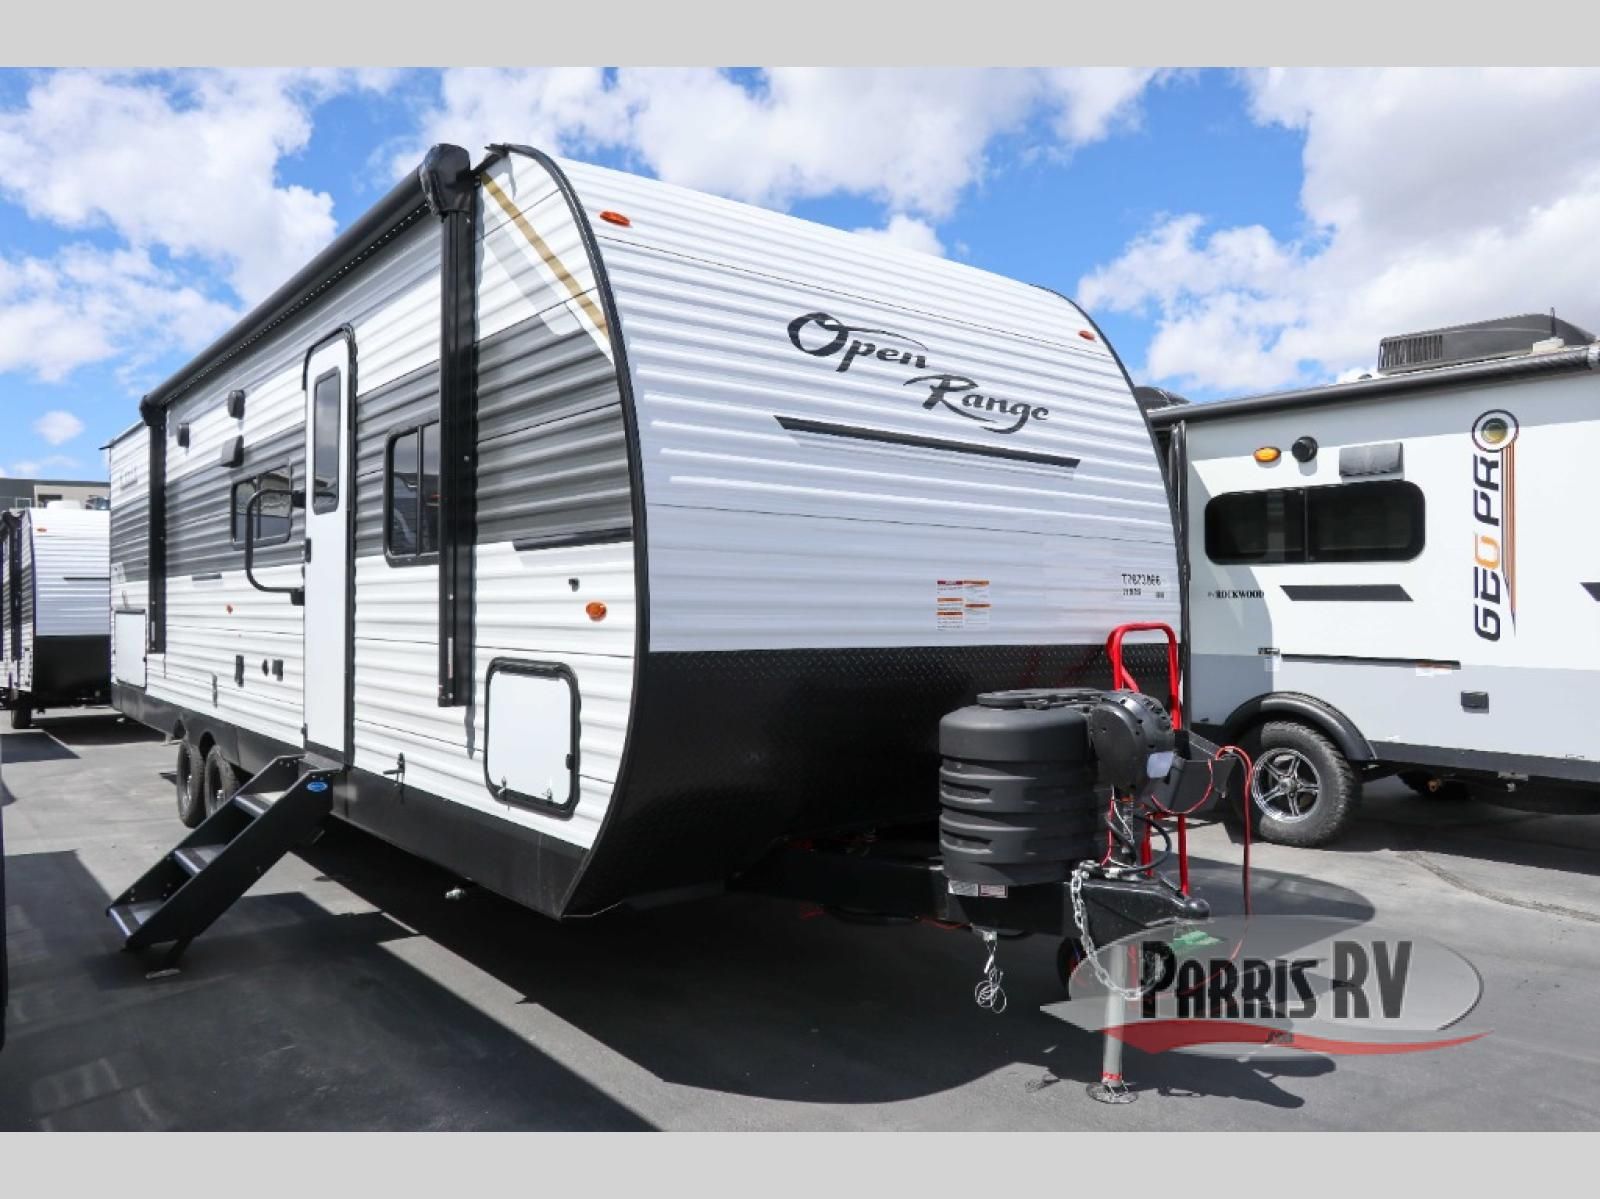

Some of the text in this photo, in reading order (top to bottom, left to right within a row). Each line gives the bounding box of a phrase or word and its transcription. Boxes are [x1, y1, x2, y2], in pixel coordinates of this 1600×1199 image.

[787, 311, 929, 373] Open
[903, 374, 1050, 434] Range
[1471, 408, 1519, 642] GEO PRO
[1215, 590, 1265, 599] ROCKWOOD
